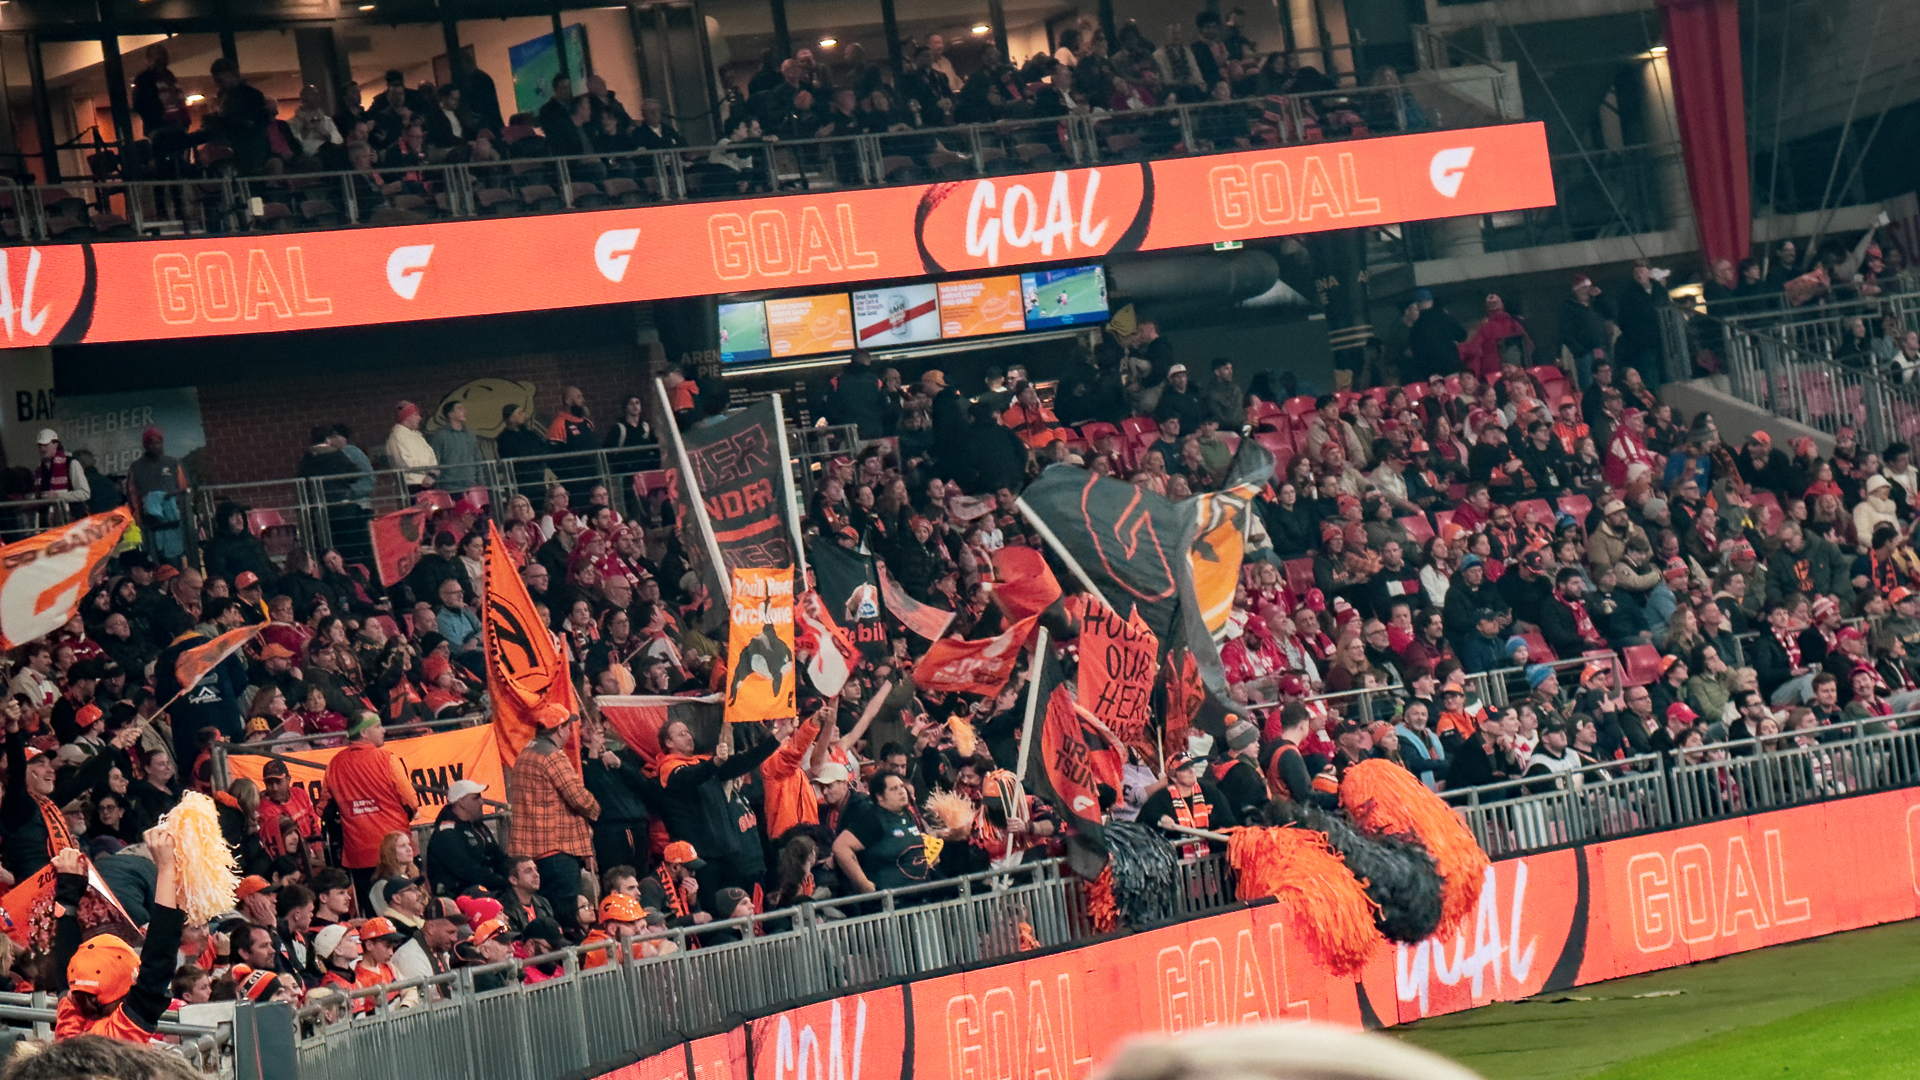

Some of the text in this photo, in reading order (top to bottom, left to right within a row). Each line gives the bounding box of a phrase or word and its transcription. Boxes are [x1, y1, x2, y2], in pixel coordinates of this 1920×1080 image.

[965, 168, 1109, 266] GOAL
[1210, 152, 1381, 230] GOAL
[707, 203, 879, 281] GOAL
[153, 246, 332, 325] GOAL
[105, 405, 154, 433] BEER
[1106, 644, 1151, 683] OUR
[1628, 829, 1810, 954] GOAL
[1157, 923, 1310, 1035] GOAL
[946, 973, 1093, 1080] GOAL
